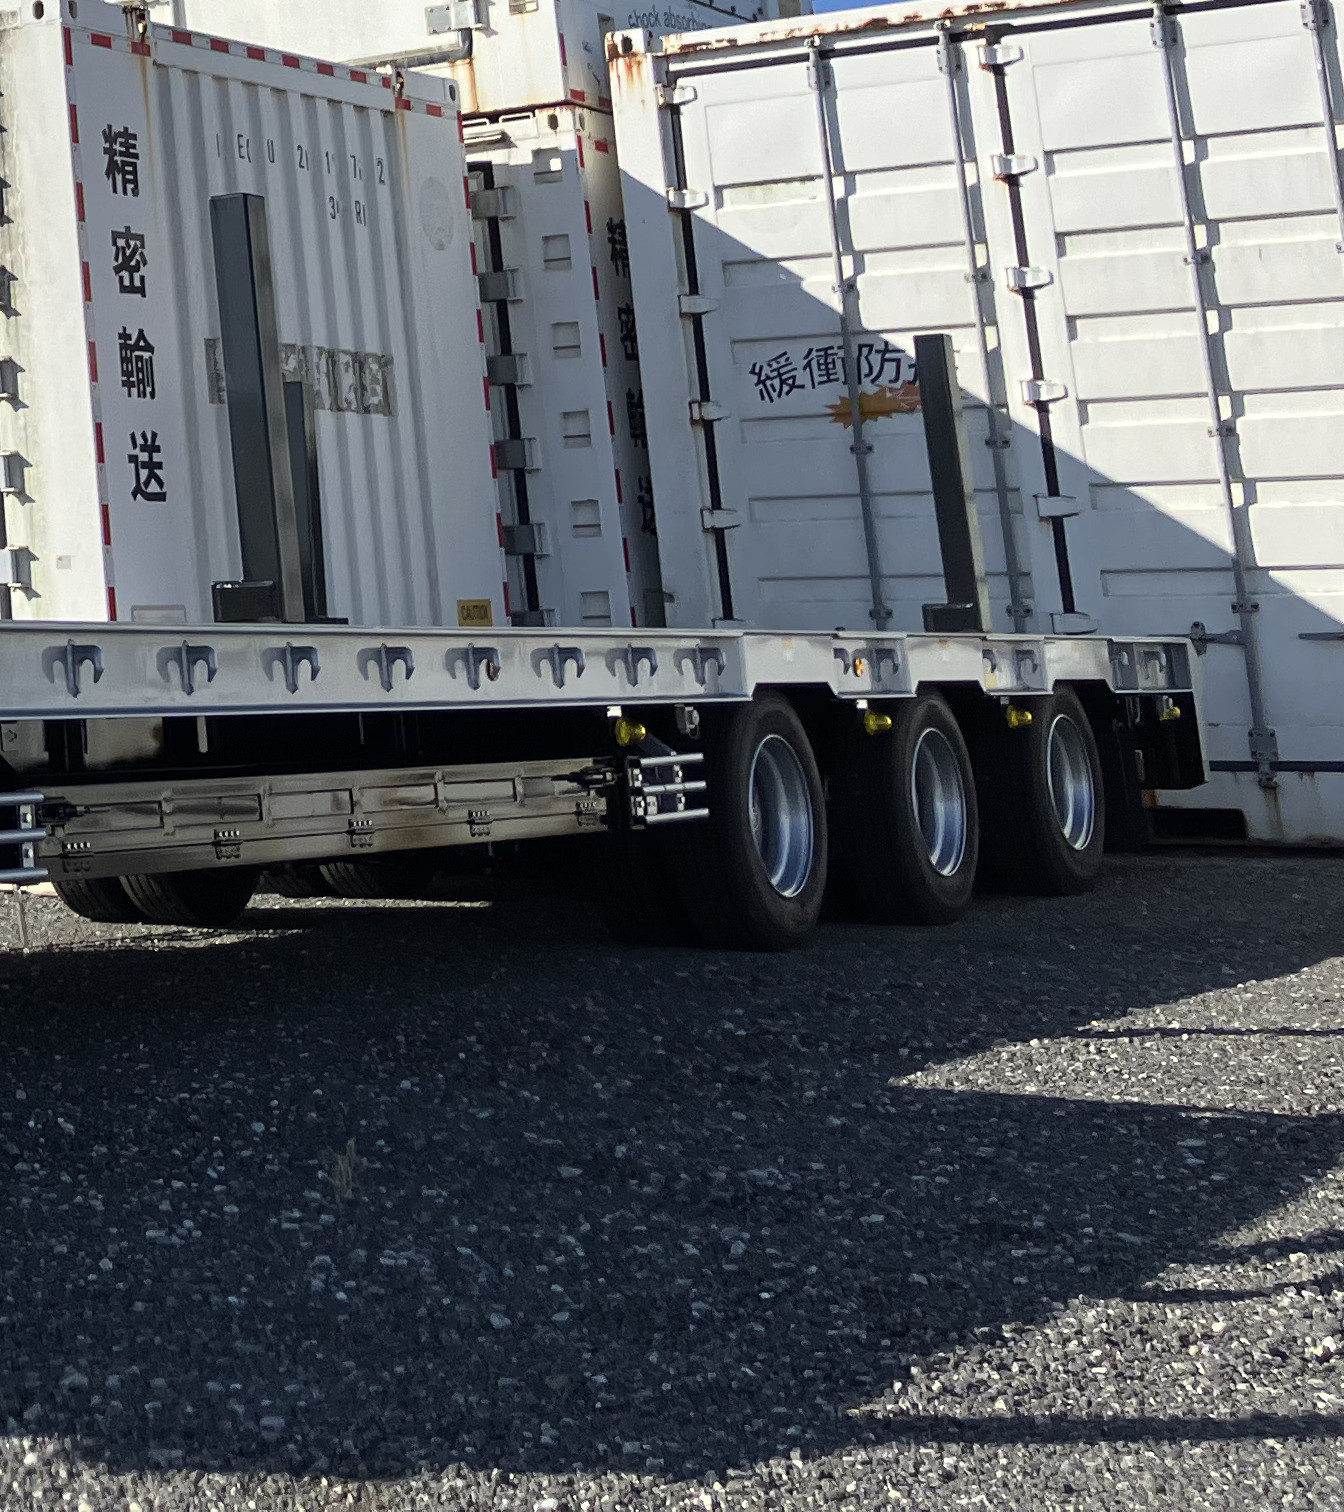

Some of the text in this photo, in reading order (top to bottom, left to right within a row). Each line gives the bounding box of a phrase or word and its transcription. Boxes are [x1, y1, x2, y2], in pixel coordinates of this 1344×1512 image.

[101, 123, 167, 503] 精密輸送
[748, 340, 919, 403] 緩衝防
